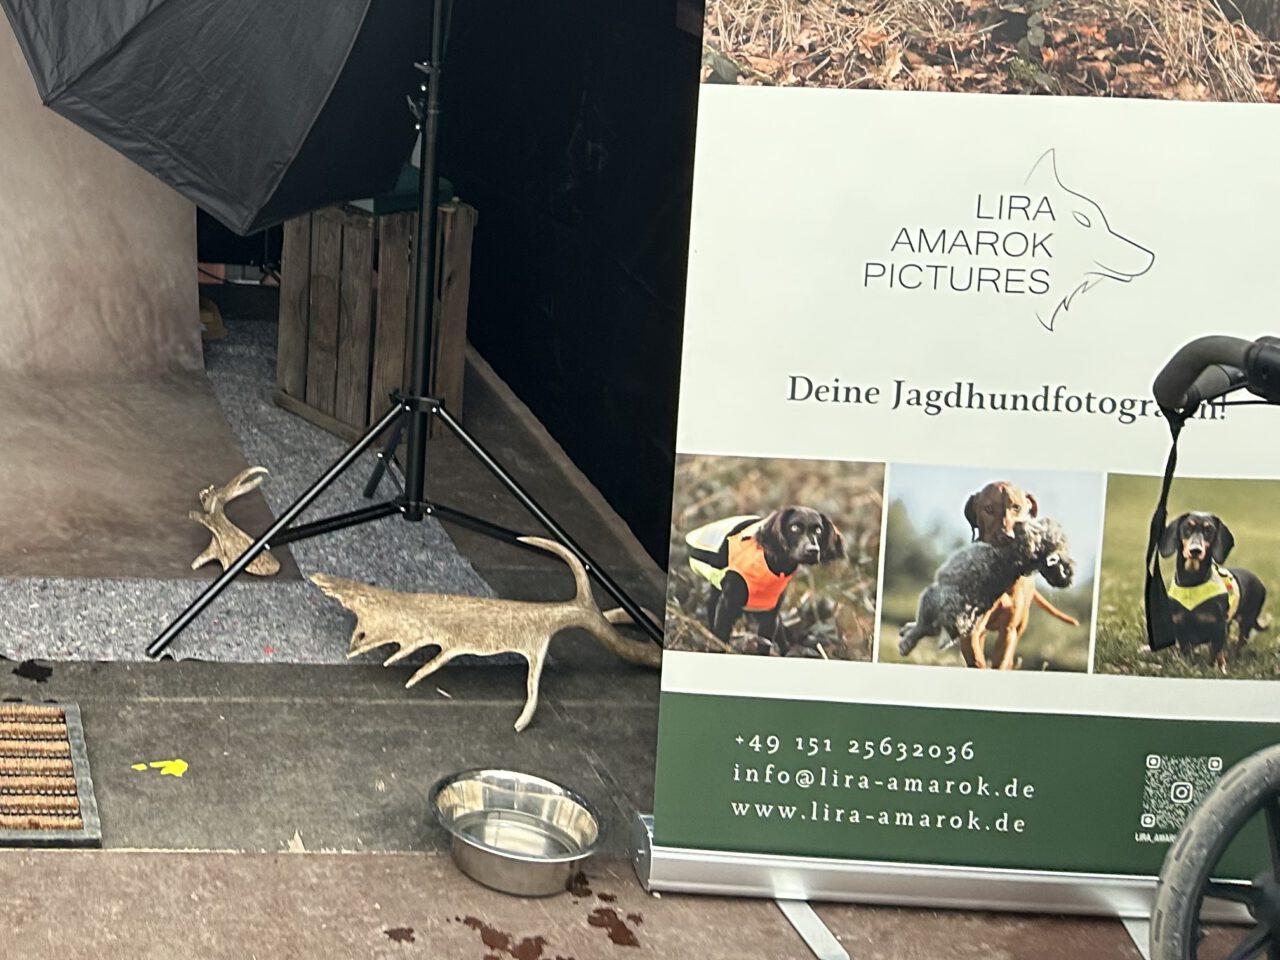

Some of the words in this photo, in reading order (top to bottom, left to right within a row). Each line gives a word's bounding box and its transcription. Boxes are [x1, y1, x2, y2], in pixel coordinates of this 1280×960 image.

[976, 194, 1056, 221] LIRA
[890, 227, 1054, 258] AMAROK
[864, 262, 1051, 295] PICTURES
[786, 375, 881, 405] Deine
[734, 734, 781, 754] +49
[795, 737, 833, 757] 151
[847, 736, 976, 765] 25632036
[732, 763, 1036, 799] info@lira-amarok.de
[730, 800, 1026, 833] www.lira-amarok.de
